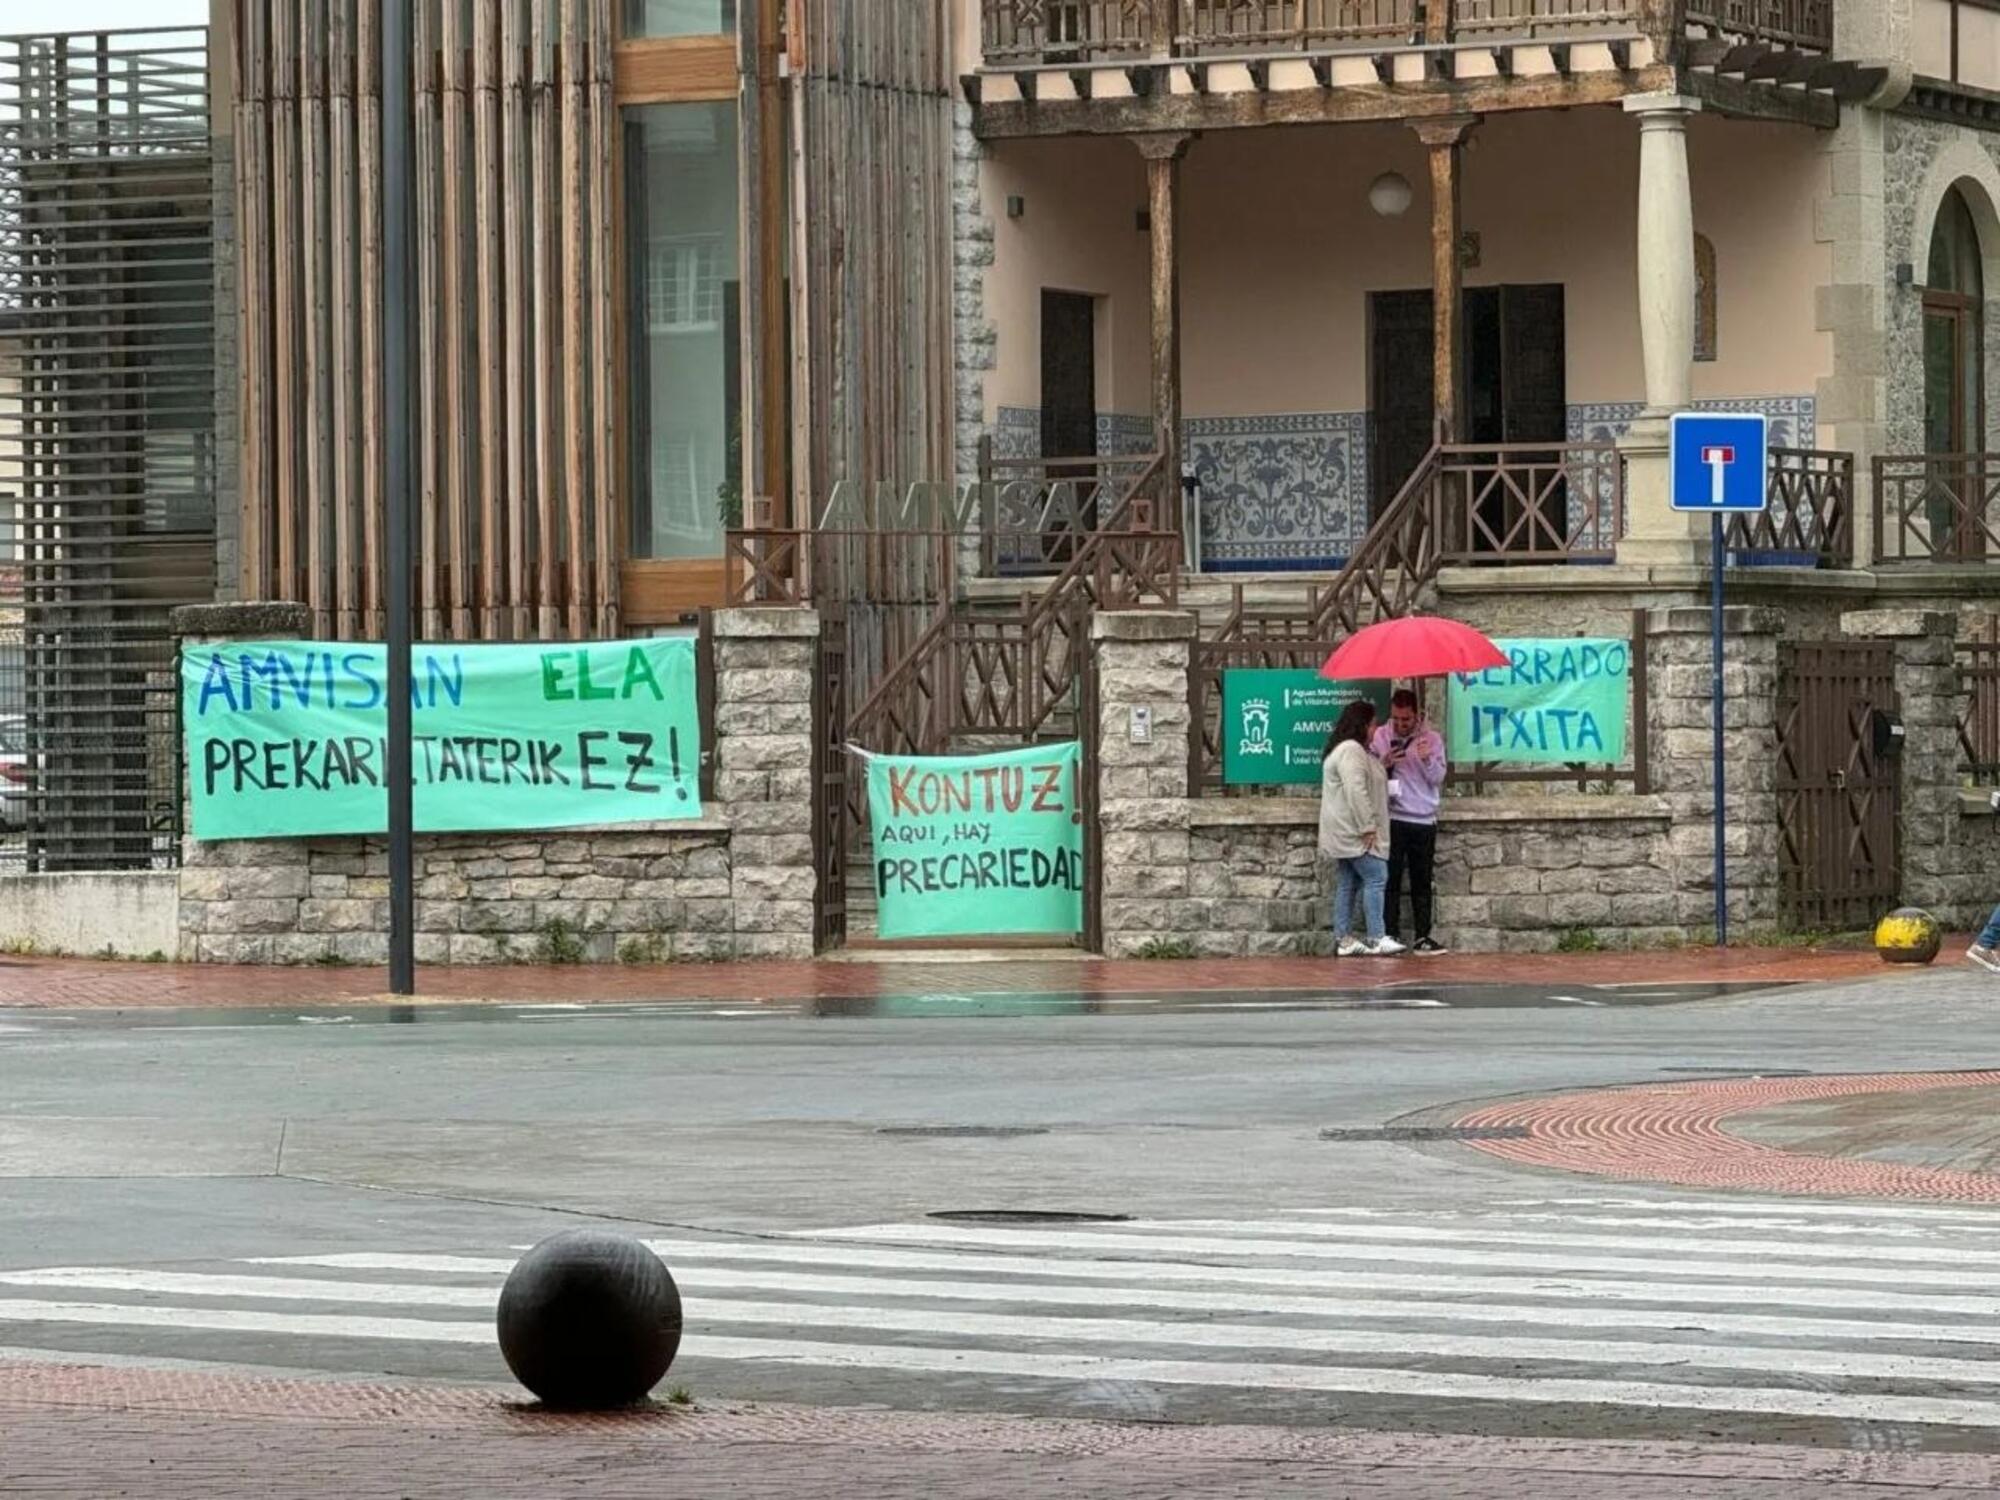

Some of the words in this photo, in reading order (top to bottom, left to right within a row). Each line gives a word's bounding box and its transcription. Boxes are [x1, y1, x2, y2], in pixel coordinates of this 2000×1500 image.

[819, 480, 1089, 532] AMVISA
[540, 646, 664, 701] ELA
[1293, 721, 1334, 733] AMVIS
[1472, 705, 1603, 751] ITXITA
[205, 735, 570, 795] PREKARITATERIK
[579, 726, 688, 801] EZ!
[889, 757, 1082, 825] KONTUZ!
[953, 822, 991, 844] HAY
